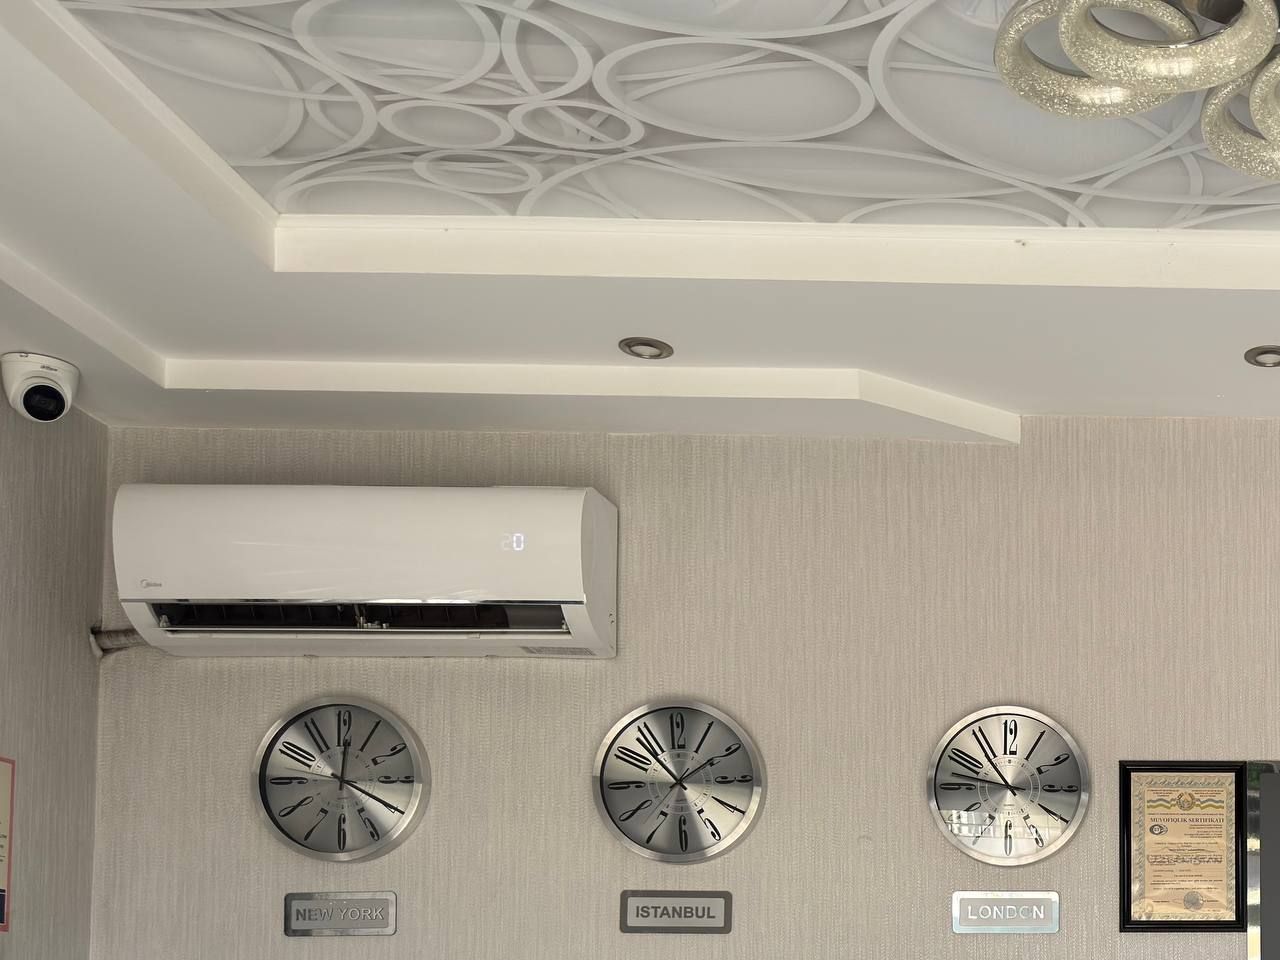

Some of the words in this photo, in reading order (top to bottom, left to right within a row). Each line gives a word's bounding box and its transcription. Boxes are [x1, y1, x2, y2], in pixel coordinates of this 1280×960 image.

[304, 717, 331, 754] 11
[336, 710, 352, 747] 12
[359, 719, 382, 752] 1
[636, 721, 667, 757] 11
[669, 712, 687, 750] 12
[693, 720, 715, 754] 1
[971, 725, 998, 759] 11
[1002, 719, 1019, 756] 12
[278, 741, 316, 770] 10
[371, 742, 407, 766] 2
[1024, 729, 1047, 761] 1
[613, 746, 652, 774] 10
[947, 747, 984, 776] 10
[1036, 752, 1071, 775] 2
[269, 776, 309, 786] 9
[377, 775, 415, 785] 3
[607, 780, 647, 791] 9
[714, 774, 753, 785] 3
[939, 782, 977, 792] 9
[1042, 783, 1079, 793] 3
[278, 795, 314, 818] 8
[618, 799, 653, 822] 8
[711, 795, 747, 816] 4
[1037, 803, 1070, 825] 4
[303, 807, 329, 842] 7
[337, 813, 347, 851] 6
[357, 806, 380, 842] 5
[646, 809, 669, 845] 7
[678, 814, 689, 853] 6
[696, 807, 722, 842] 5
[1003, 819, 1013, 857] 6
[1023, 814, 1045, 848] 5
[295, 907, 333, 921] NEW
[338, 907, 384, 921] YORK
[635, 905, 716, 919] ISTANBUL
[967, 905, 1045, 919] LONDON
